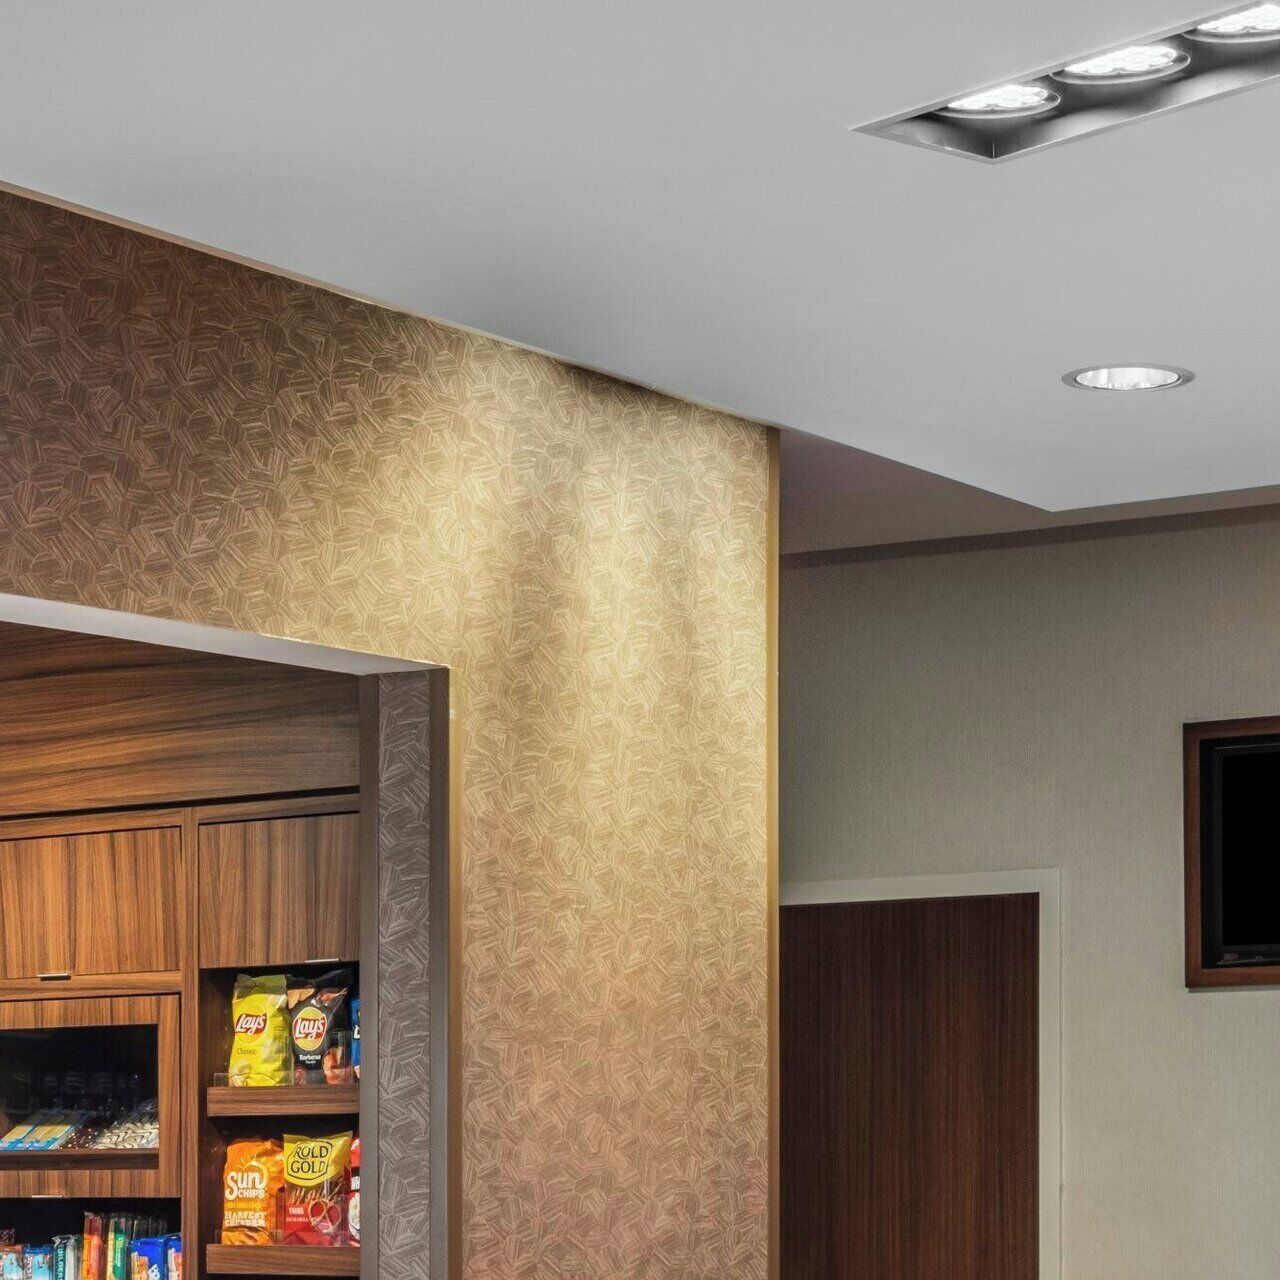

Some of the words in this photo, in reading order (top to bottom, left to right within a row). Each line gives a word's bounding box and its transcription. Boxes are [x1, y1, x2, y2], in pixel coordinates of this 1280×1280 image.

[293, 1145, 329, 1159] ROLD
[290, 1160, 325, 1174] GOLD
[225, 1171, 267, 1200] Sun
[237, 1188, 266, 1199] CHIPS
